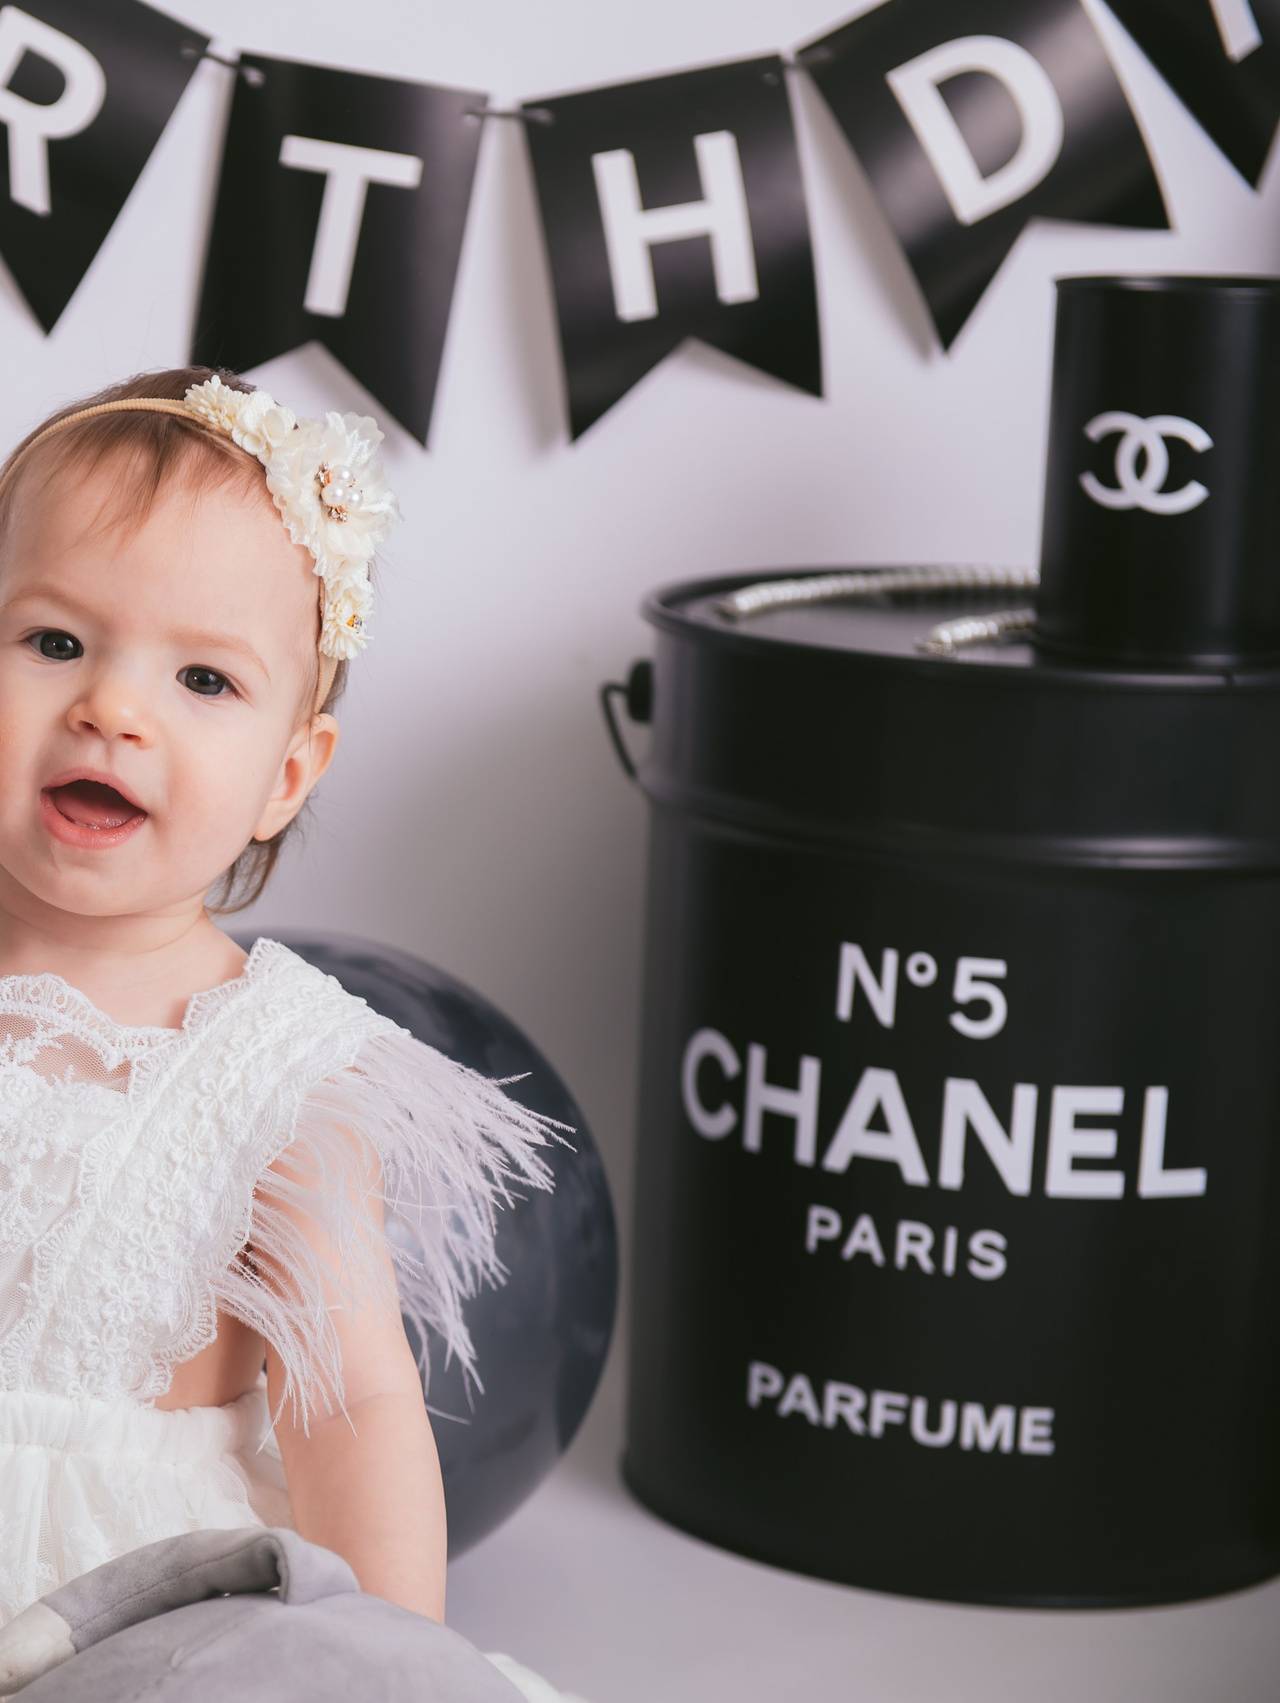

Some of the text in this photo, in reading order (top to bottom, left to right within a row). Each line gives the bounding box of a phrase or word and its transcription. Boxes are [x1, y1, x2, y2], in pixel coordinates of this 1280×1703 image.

[682, 1027, 1208, 1199] CHANEL
[806, 1204, 1008, 1281] PARIS
[747, 1360, 1056, 1456] PARFUME
